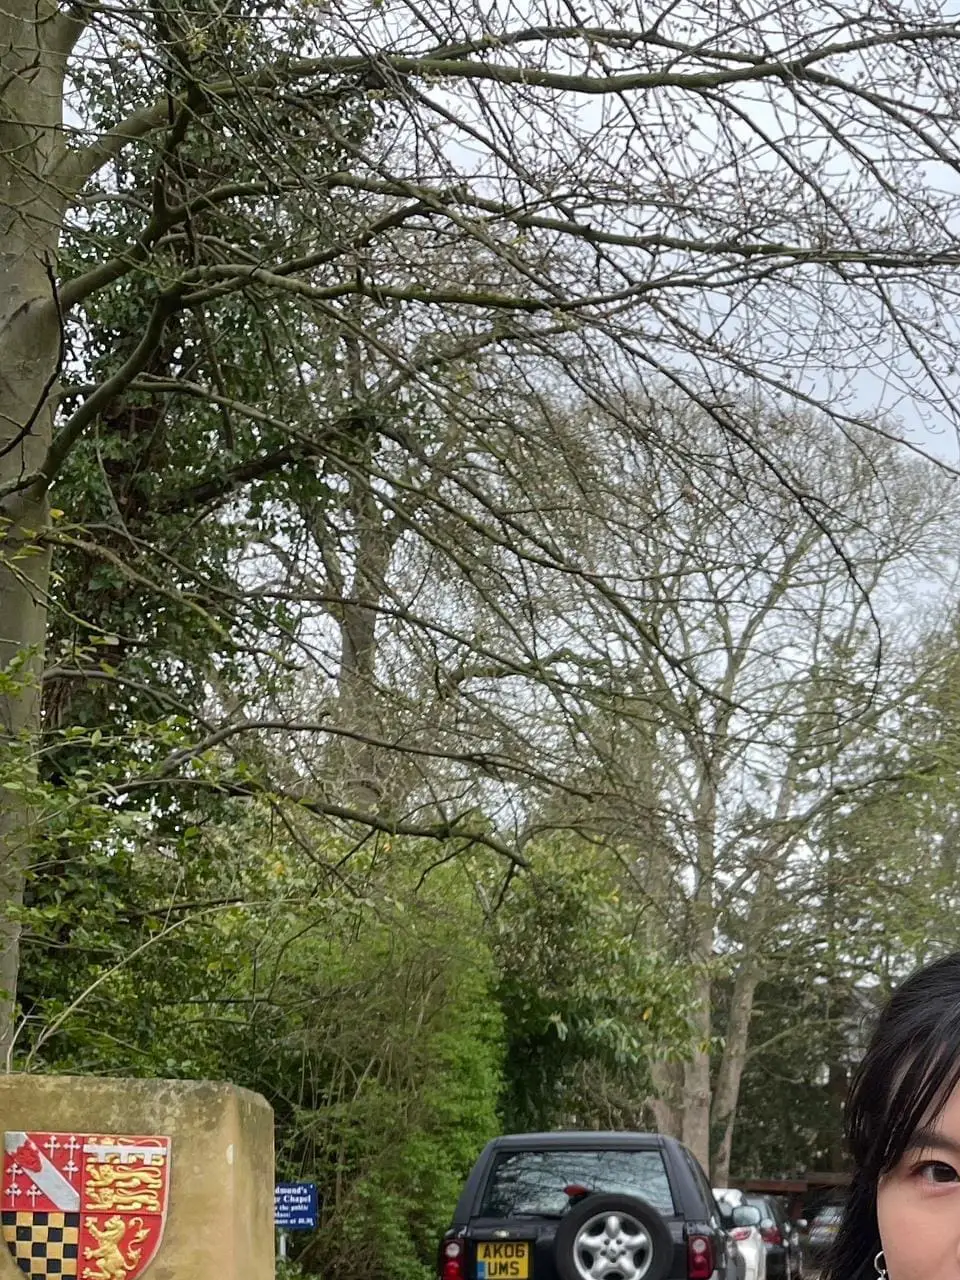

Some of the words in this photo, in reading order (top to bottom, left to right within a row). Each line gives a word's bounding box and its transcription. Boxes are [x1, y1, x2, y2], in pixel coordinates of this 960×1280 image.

[283, 1194, 311, 1204] Chapel
[483, 1243, 525, 1259] AK06
[488, 1261, 520, 1276] UMS
